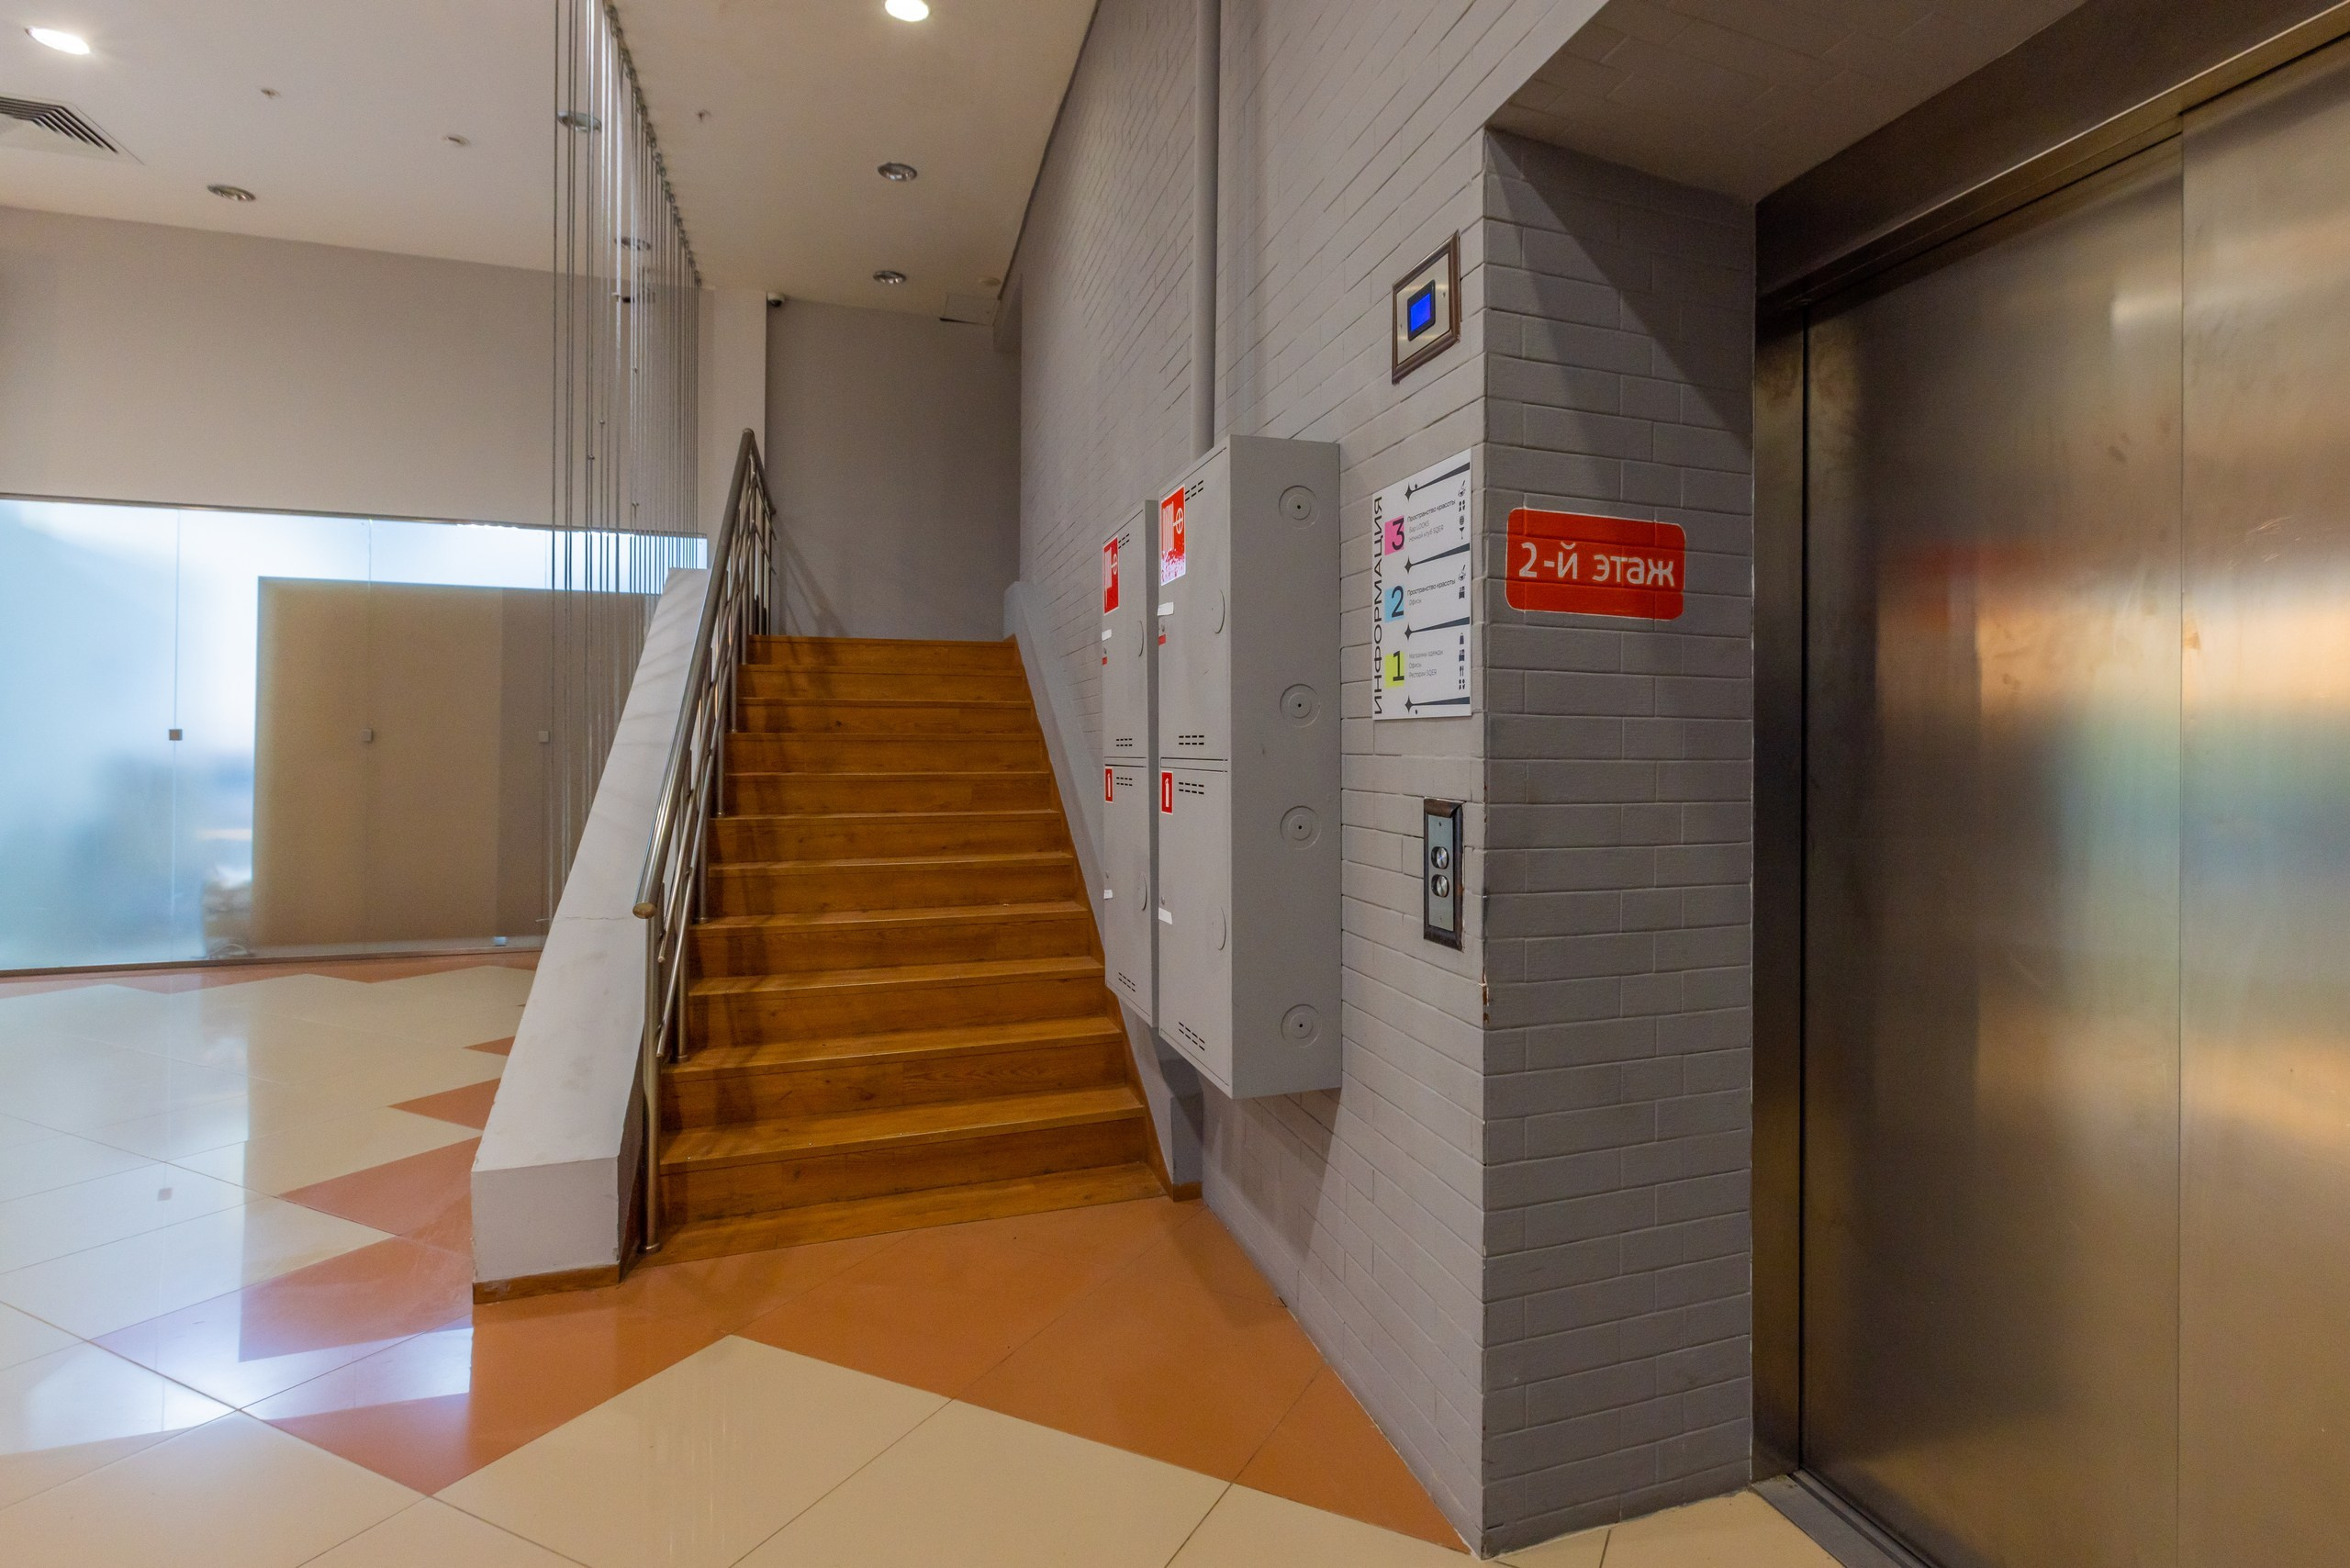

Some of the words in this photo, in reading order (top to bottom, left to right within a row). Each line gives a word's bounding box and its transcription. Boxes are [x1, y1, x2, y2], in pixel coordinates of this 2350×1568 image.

[1392, 517, 1404, 551] 3
[1519, 542, 1578, 579] 2-й
[1593, 554, 1674, 587] этаж
[1374, 497, 1383, 714] ИНФОРМАЦИЯ
[1392, 586, 1404, 618] 2
[1393, 651, 1404, 681] 1
